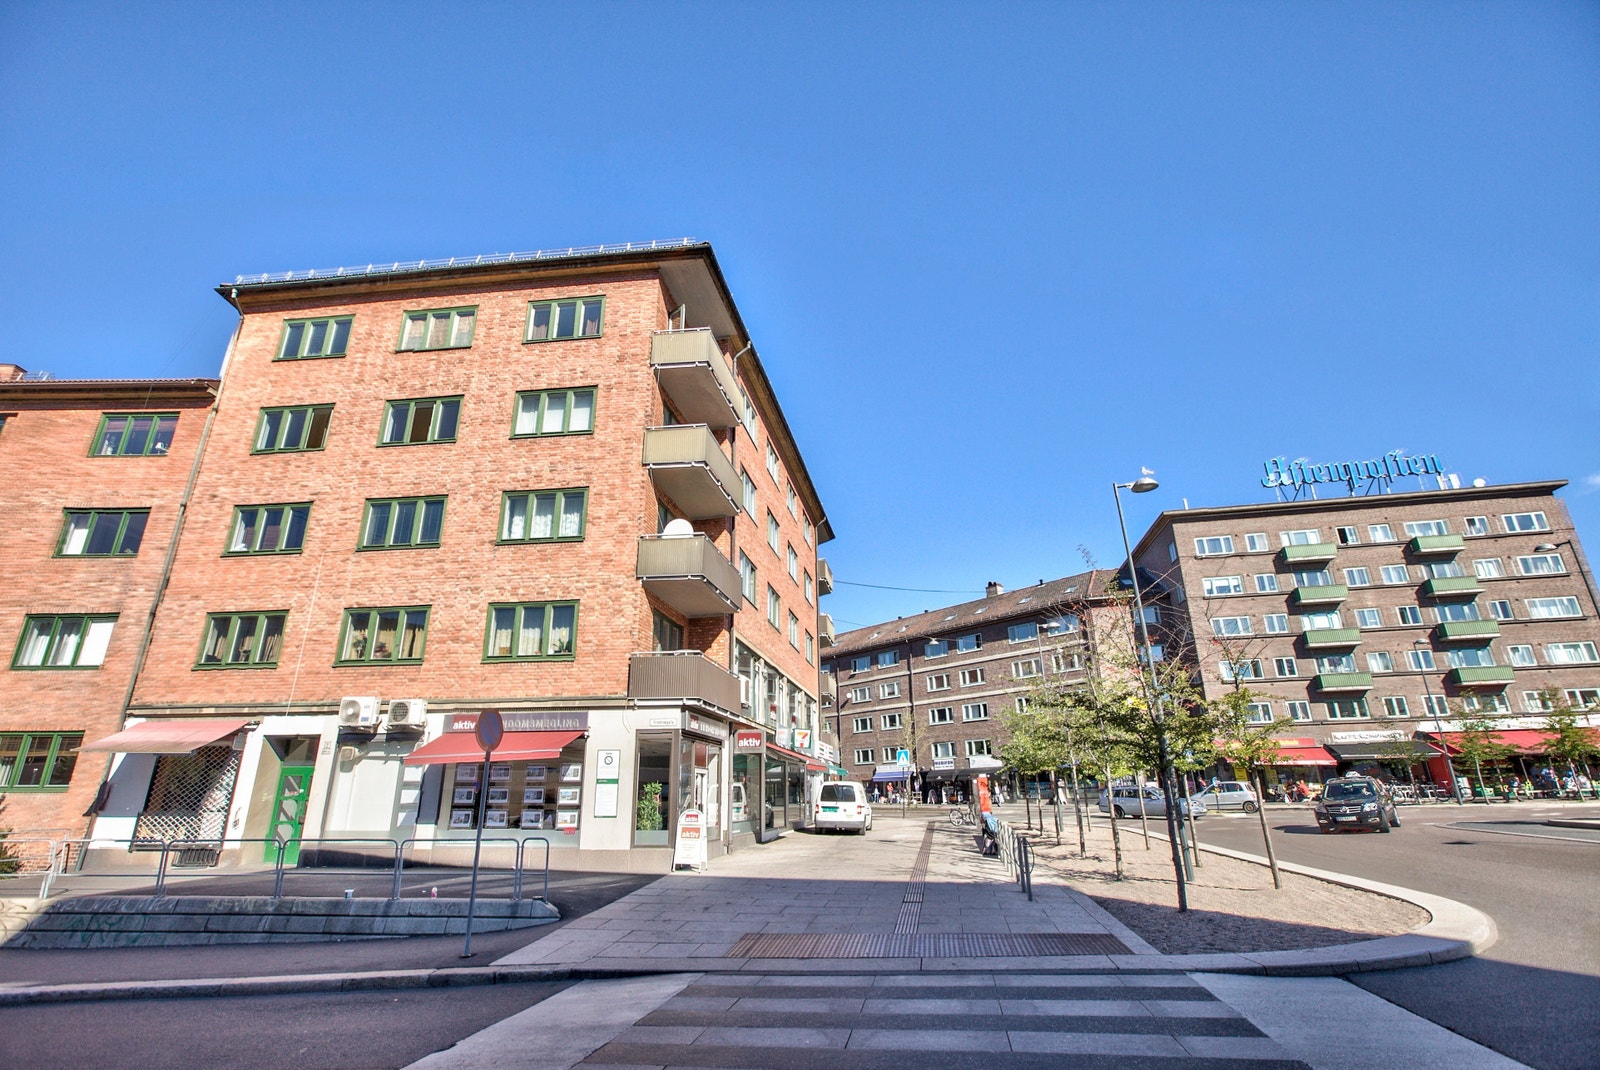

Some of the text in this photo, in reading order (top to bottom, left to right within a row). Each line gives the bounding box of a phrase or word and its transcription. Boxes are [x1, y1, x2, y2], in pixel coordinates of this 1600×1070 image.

[1261, 449, 1445, 490] Aftenposten
[453, 718, 580, 730] aktiv NDOMSMEGLING
[738, 737, 761, 748] aktiv
[682, 830, 700, 838] aktiv
